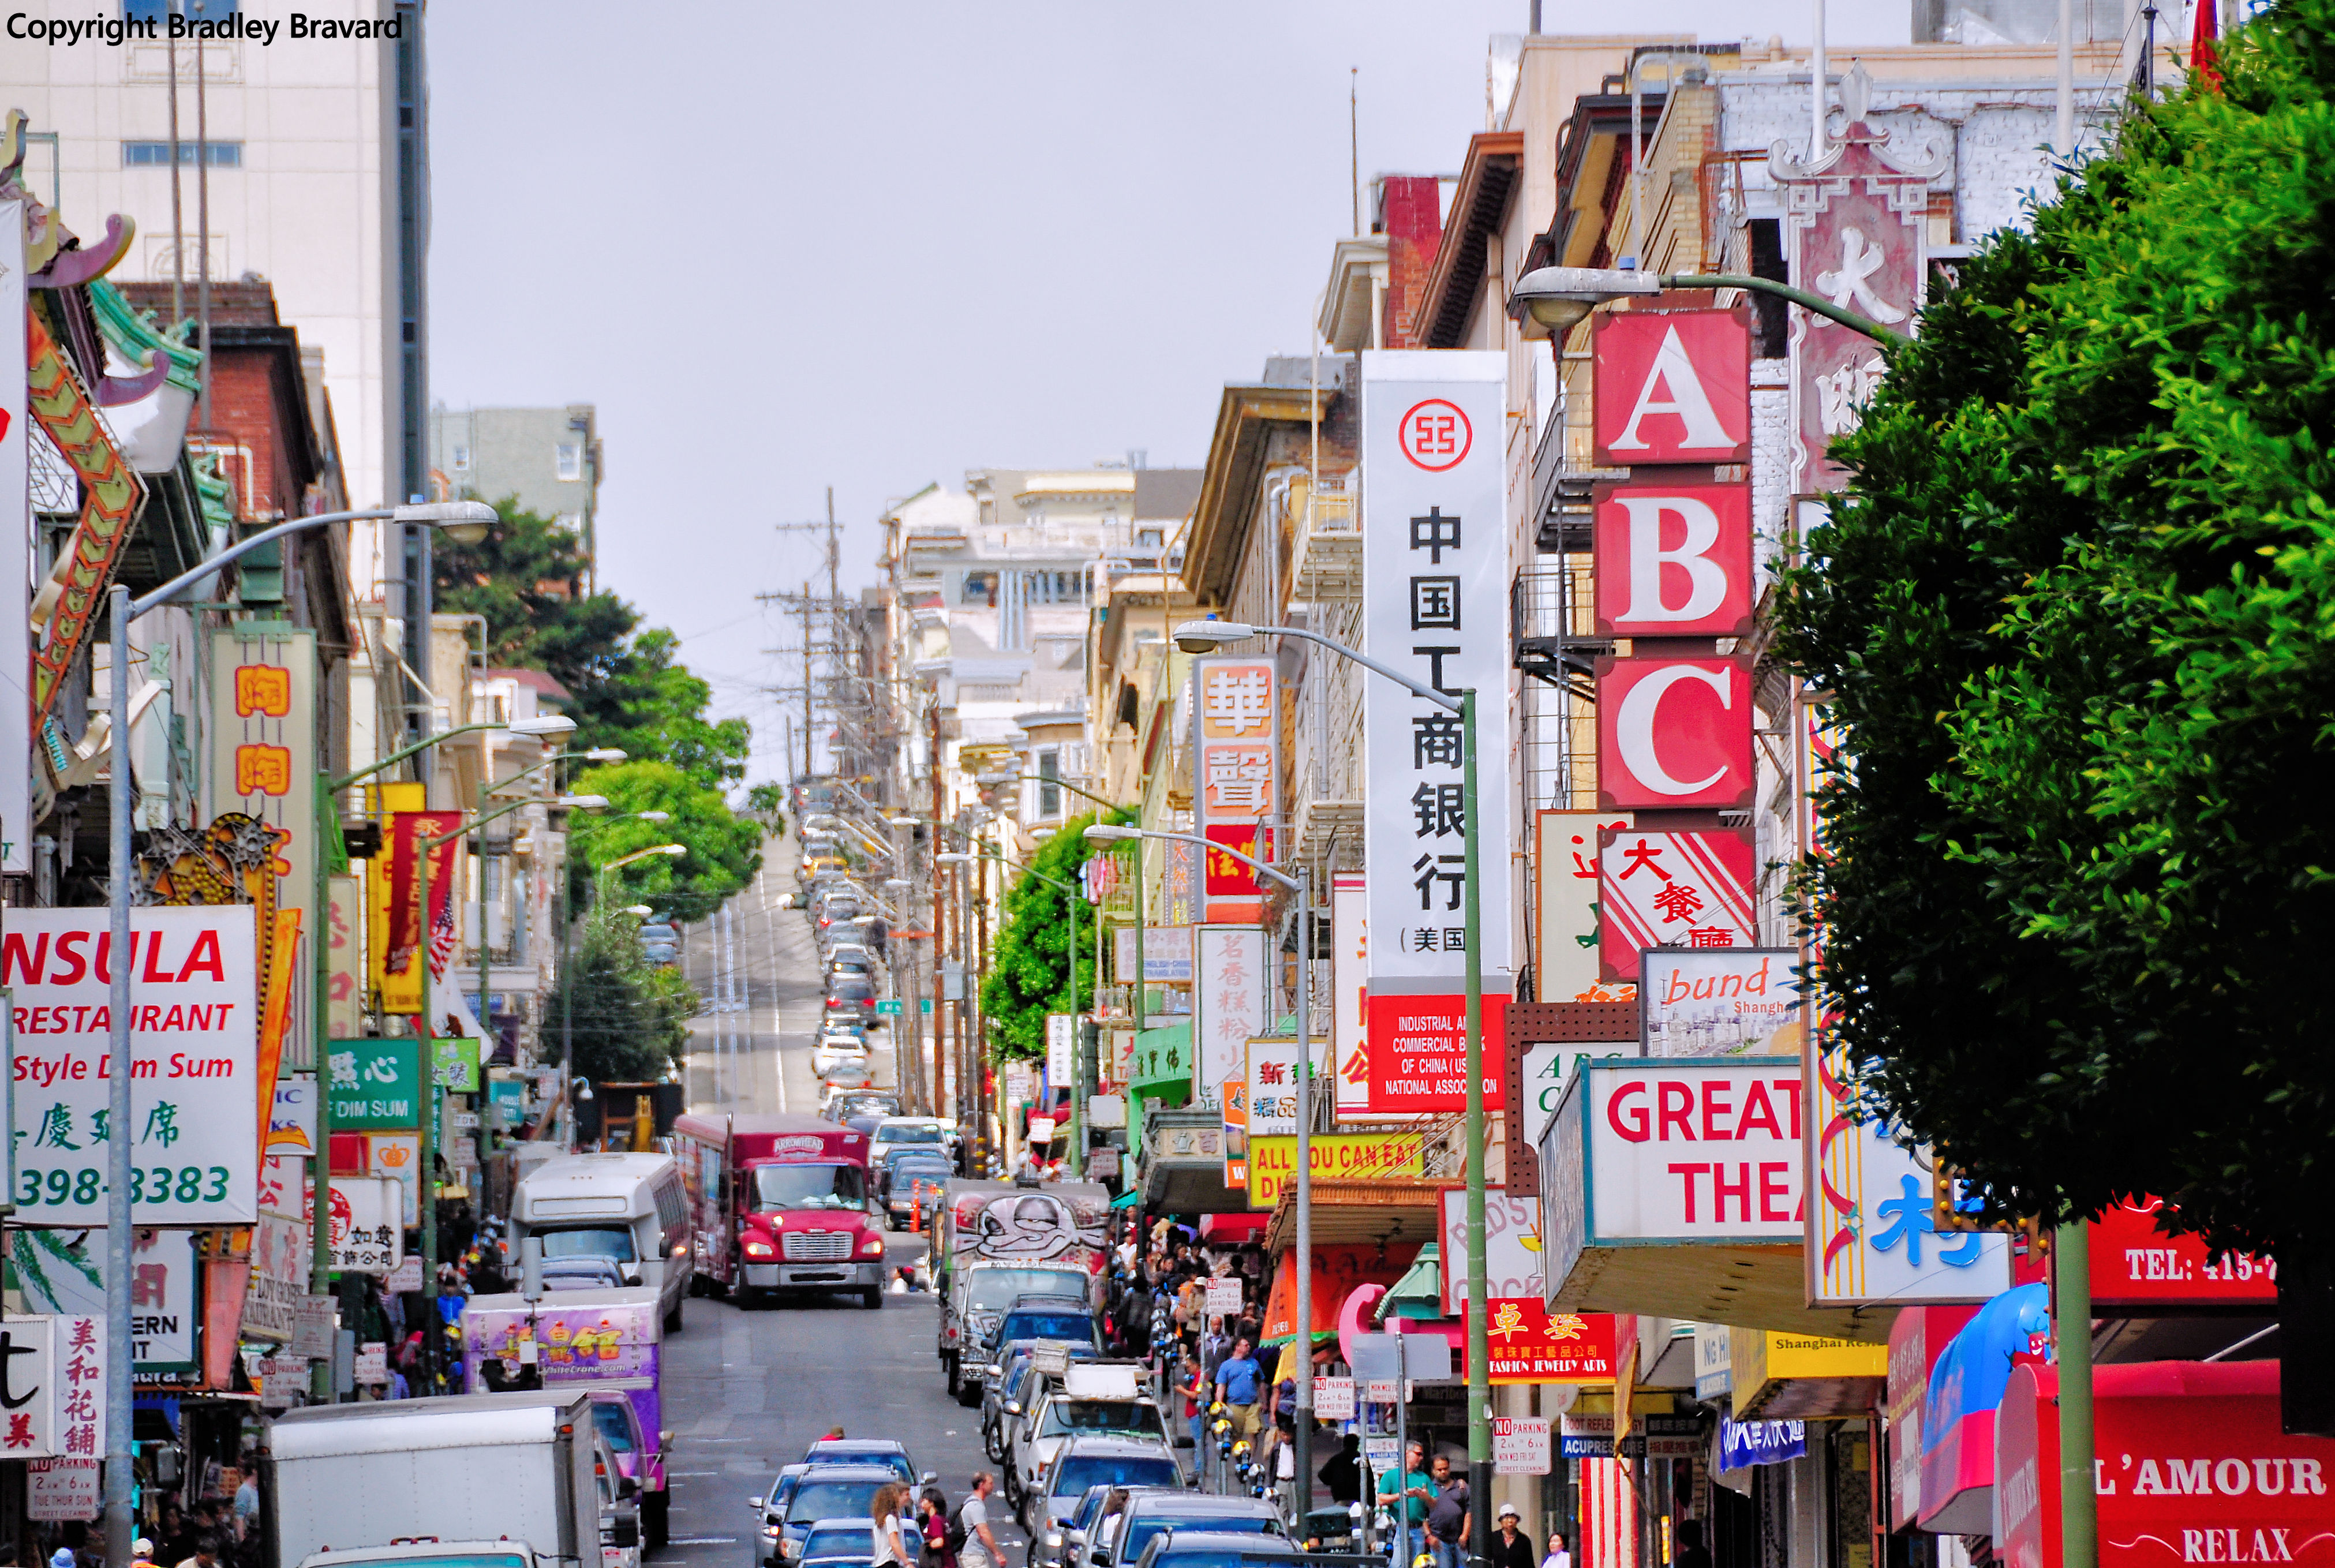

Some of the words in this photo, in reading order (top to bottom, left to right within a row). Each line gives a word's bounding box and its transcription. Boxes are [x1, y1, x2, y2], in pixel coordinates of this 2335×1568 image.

[1409, 506, 1465, 911] 中国工商银行
[1666, 957, 1769, 1005] bund
[1734, 1001, 1797, 1015] Shangh
[1398, 1016, 1453, 1032] INDUSTRIAL
[1457, 1016, 1467, 1031] AN
[1393, 1038, 1455, 1053] COMMERCIAL
[1459, 1036, 1486, 1052] BK
[14, 1053, 87, 1087] Style
[98, 1056, 157, 1079] Dm
[168, 1052, 233, 1078] Sum
[1401, 1059, 1415, 1074] OF
[1419, 1058, 1447, 1073] CHINA
[1385, 1080, 1432, 1095] NATIONAL
[1435, 1079, 1497, 1095] ASSOCON
[336, 1101, 367, 1118] DIM
[372, 1100, 408, 1117] SUM
[1607, 1080, 1802, 1143] GREAT
[1258, 1147, 1290, 1170] ALL
[1297, 1146, 1332, 1167] OU
[1340, 1145, 1378, 1168] CAN
[1384, 1143, 1416, 1167] EAT
[2126, 1249, 2192, 1281] TEL:
[1208, 1279, 1217, 1288] NO
[1776, 1339, 1841, 1350] Shanghai
[1489, 1360, 1529, 1373] FASHION
[1533, 1360, 1578, 1372] JEWELRY
[1582, 1359, 1607, 1371] ARTS
[1315, 1379, 1326, 1389] NO
[5, 1414, 35, 1449] 美
[1496, 1420, 1510, 1434] NO
[1513, 1424, 1547, 1434] PARKING
[1566, 1418, 1585, 1430] FOOT
[1587, 1418, 1644, 1432] REFLEGY
[1500, 1438, 1506, 1448] 2
[1528, 1438, 1533, 1447] 6
[1565, 1440, 1643, 1454] ACUPRESURE
[53, 1459, 96, 1469] PARKING
[36, 1477, 44, 1489] 2
[70, 1476, 77, 1489] 6
[2095, 1453, 2327, 1496] L'AMOUR
[2183, 1528, 2292, 1563] RELAX
